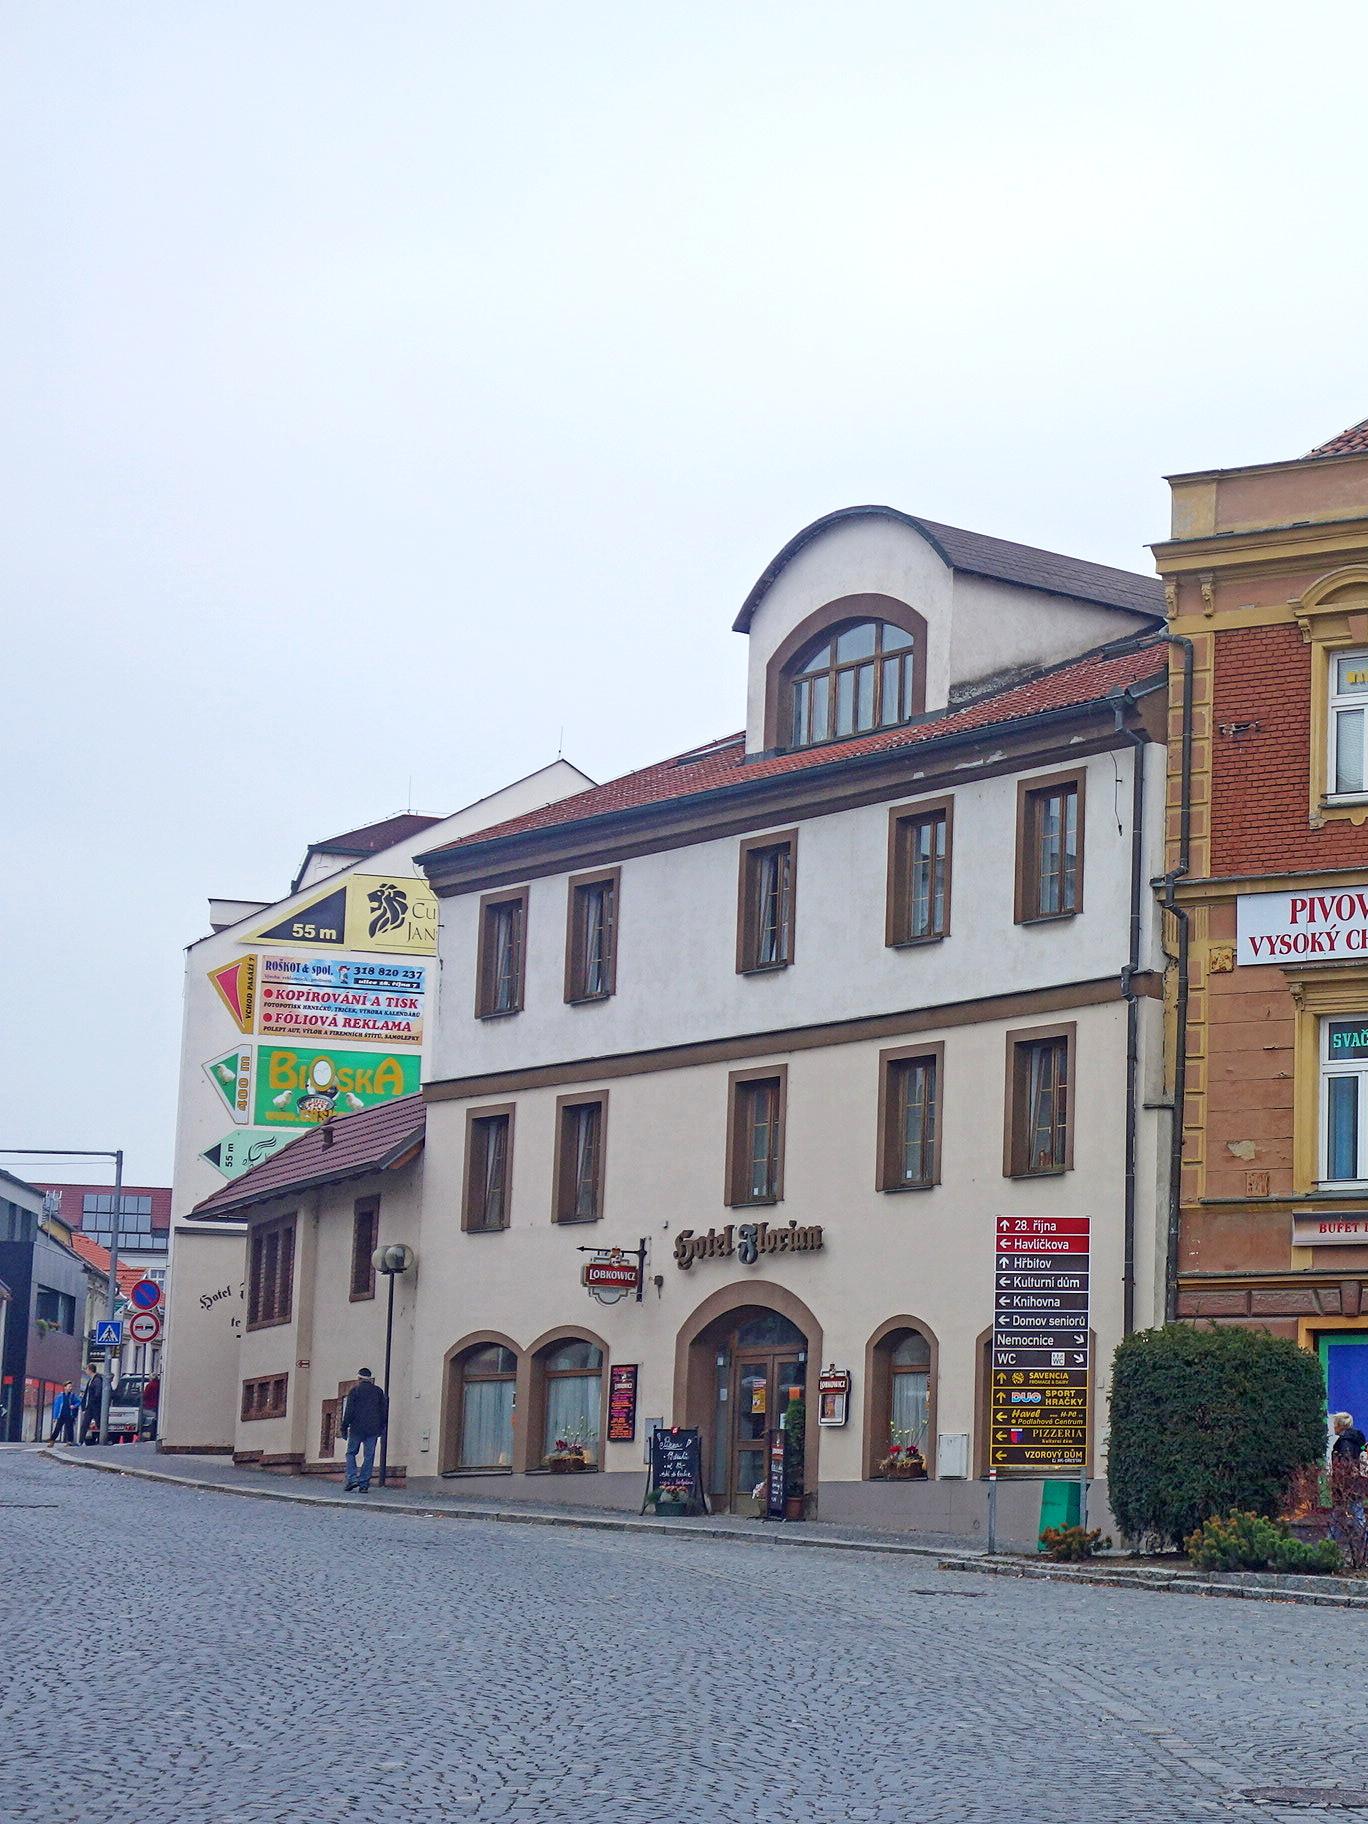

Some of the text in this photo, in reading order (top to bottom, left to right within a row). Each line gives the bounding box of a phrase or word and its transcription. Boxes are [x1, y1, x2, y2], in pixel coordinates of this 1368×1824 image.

[292, 923, 337, 940] 55 m
[1248, 924, 1339, 958] VYSOKÝ
[265, 959, 334, 976] ROŠKOT & spol.
[353, 966, 423, 979] 318 820 237
[275, 989, 418, 1009] KOPÍROVÁNÍ A TISK
[274, 1011, 412, 1032] FÓLIOVÁ REKLAMA
[225, 1156, 233, 1167] 55
[1014, 1220, 1057, 1233] 28. října
[1319, 1222, 1360, 1234] BUFET
[673, 1225, 735, 1270] Hotel
[1014, 1238, 1069, 1250] Havlíčkova
[1014, 1258, 1051, 1268] Hřbitov
[589, 1269, 636, 1280] LOBKOWICZ
[1013, 1277, 1080, 1288] Kulturní dům
[200, 1285, 231, 1311] Hotel
[1013, 1296, 1060, 1307] Knihovna
[1013, 1316, 1085, 1326] Domov seniorů
[997, 1334, 1054, 1346] Nemocnice
[997, 1353, 1016, 1364] WC
[1011, 1392, 1042, 1403] DUO
[1045, 1397, 1083, 1405] HRAČKY
[1011, 1409, 1040, 1418] Havel
[1032, 1429, 1083, 1438] PIZZERIA
[1025, 1449, 1083, 1459] VZOROVÝ DŮM
